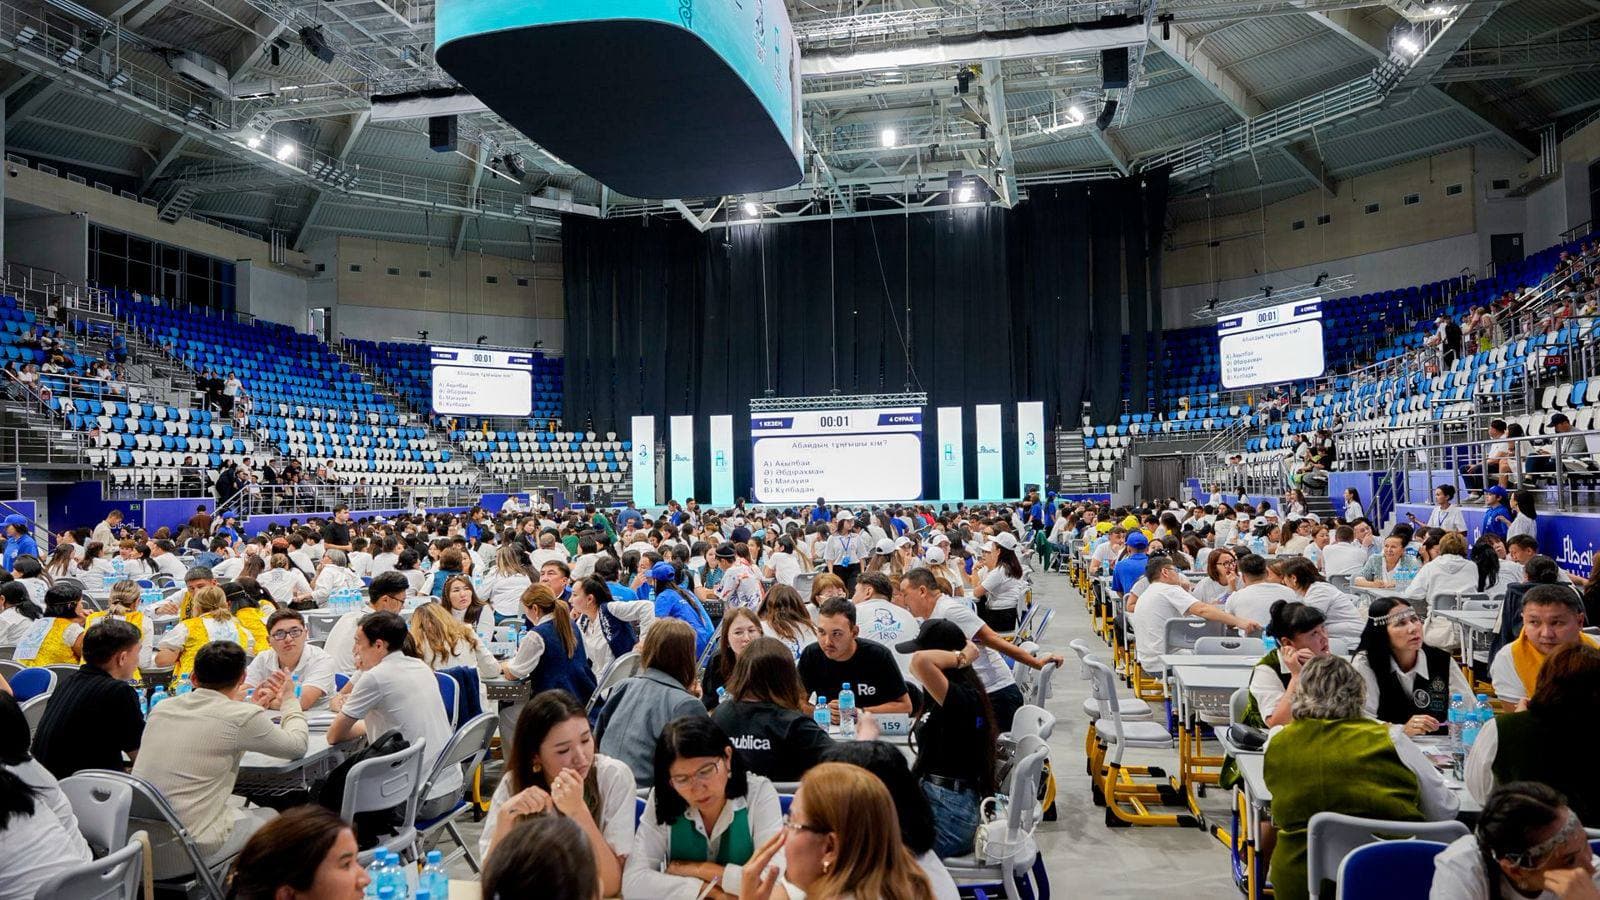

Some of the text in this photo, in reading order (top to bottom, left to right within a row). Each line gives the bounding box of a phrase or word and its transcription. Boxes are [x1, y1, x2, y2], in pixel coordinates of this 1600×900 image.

[820, 415, 849, 428] 00:01
[857, 683, 876, 696] Re
[882, 721, 901, 730] 159
